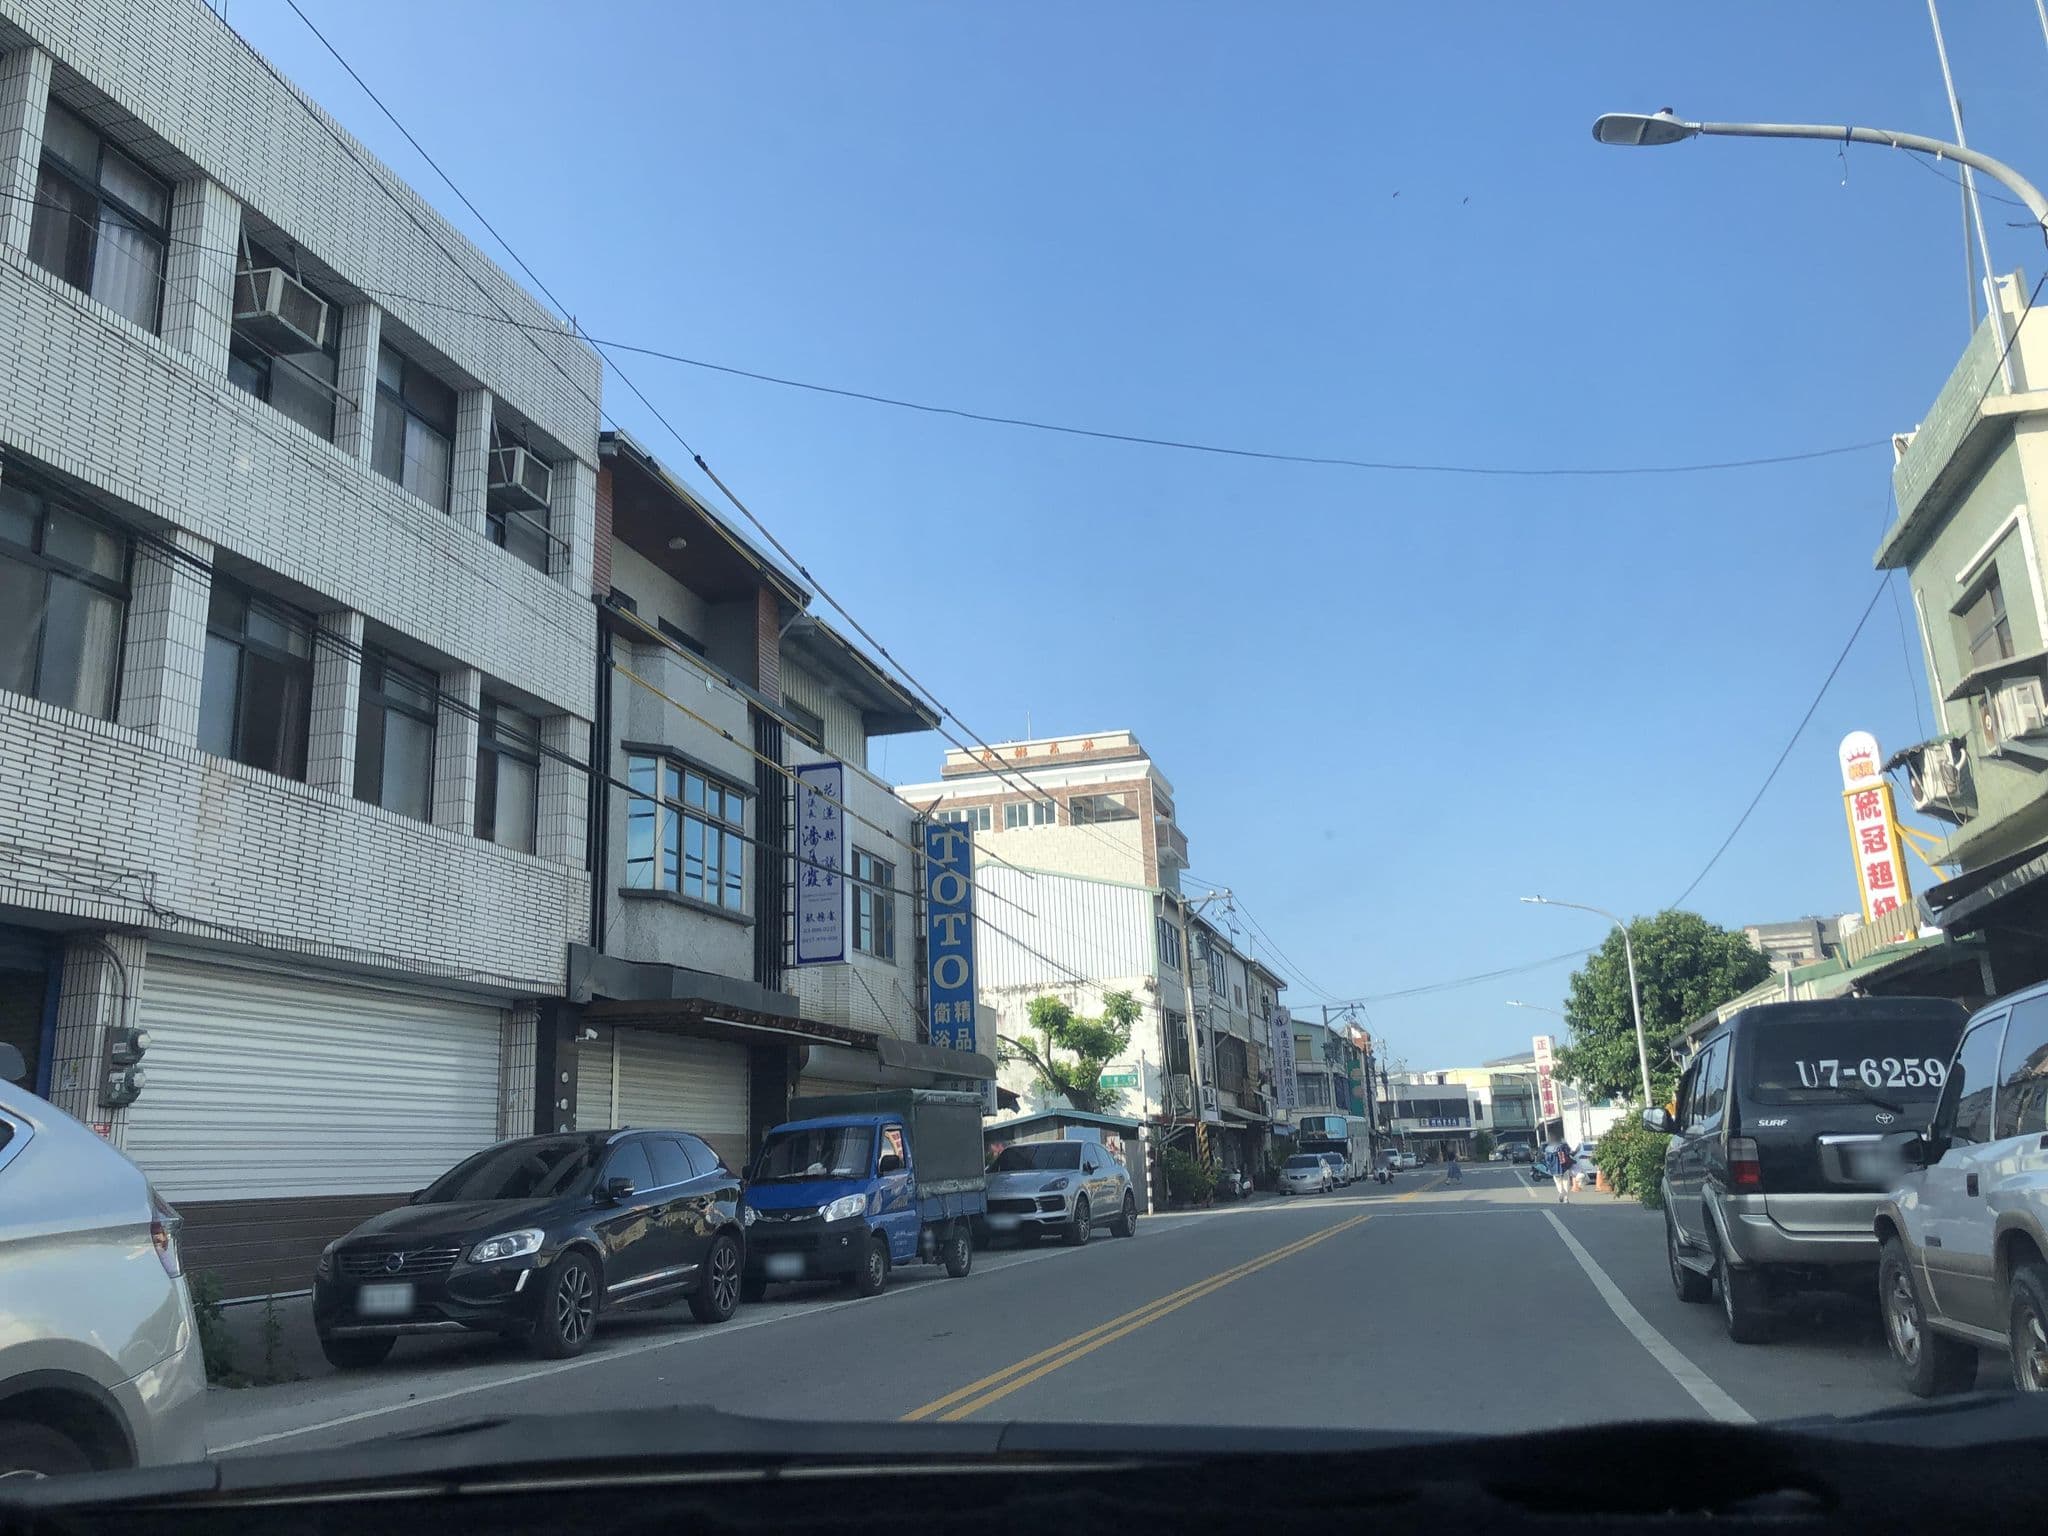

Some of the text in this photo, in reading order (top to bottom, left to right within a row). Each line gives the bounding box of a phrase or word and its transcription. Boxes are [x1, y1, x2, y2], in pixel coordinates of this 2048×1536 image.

[931, 831, 969, 990] TOTO
[1795, 1058, 1948, 1088] U7-6259
[1758, 1119, 1789, 1127] SURF
